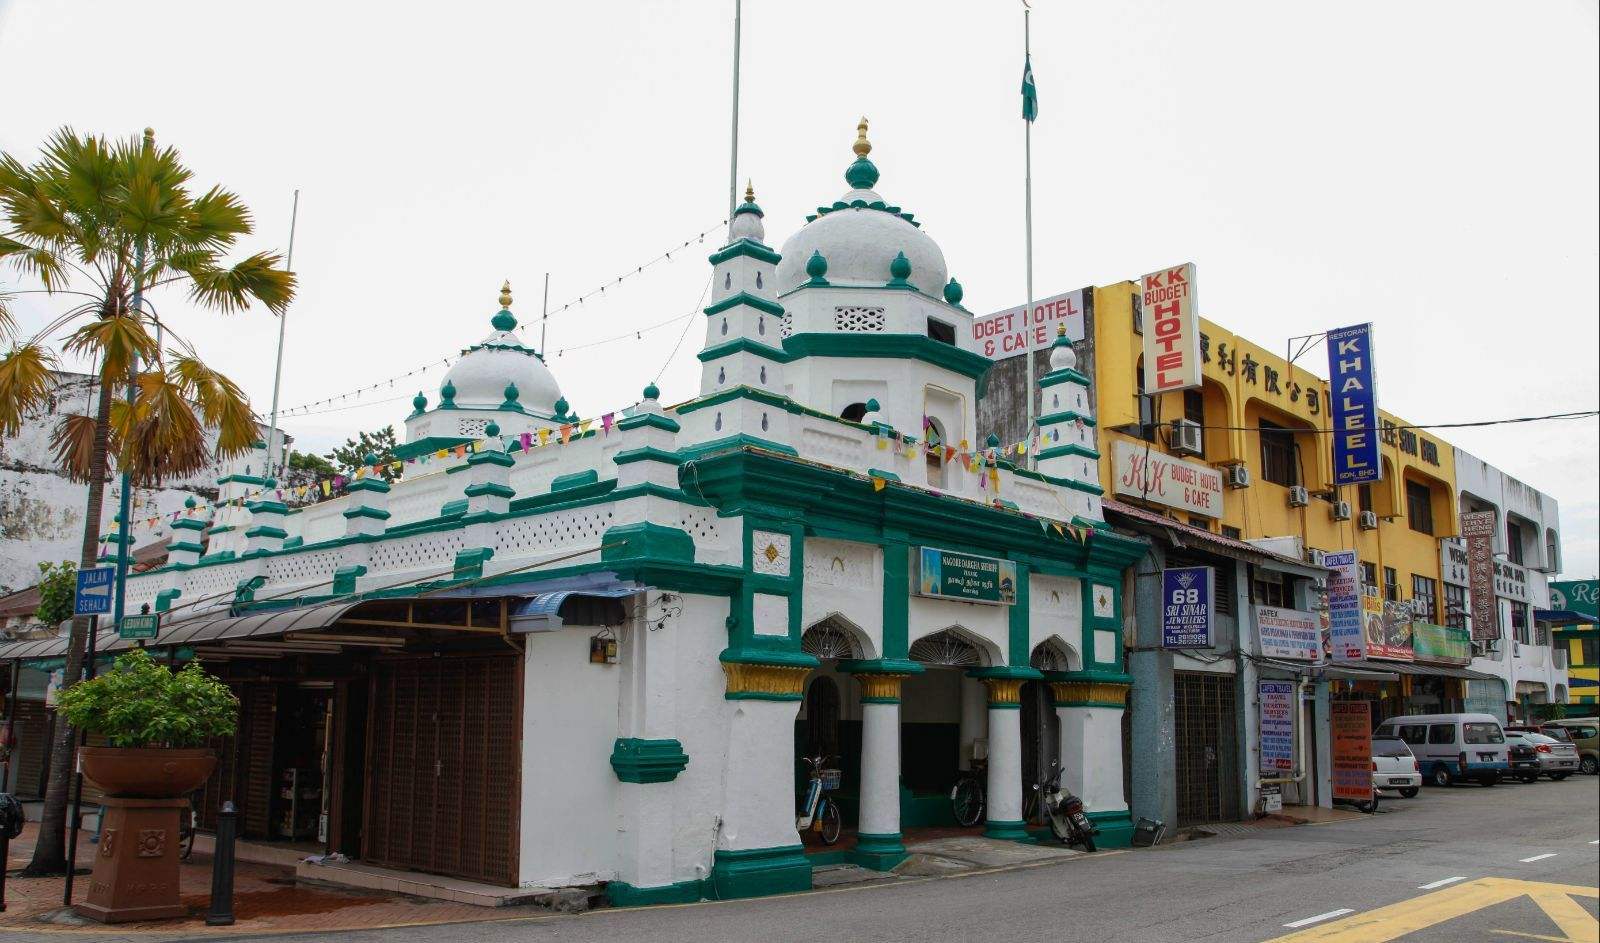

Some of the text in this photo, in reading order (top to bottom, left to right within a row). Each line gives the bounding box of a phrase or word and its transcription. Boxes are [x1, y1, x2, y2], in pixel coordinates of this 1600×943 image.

[1144, 282, 1188, 306] BUDGET
[972, 313, 1014, 340] DGET
[1328, 327, 1368, 340] RESTORAN
[1154, 299, 1183, 389] HOTEL
[1338, 338, 1368, 469] KHALEEL
[1171, 463, 1197, 486] BUDGET
[1200, 472, 1220, 493] HOTEL
[1192, 488, 1210, 509] CAFE
[1463, 512, 1492, 520] WENG
[84, 571, 107, 584] JALAN
[1173, 588, 1198, 604] 68
[80, 599, 107, 611] SEHALA
[1166, 603, 1207, 617] SRI SINAR
[1166, 615, 1206, 625] JEWELLERS
